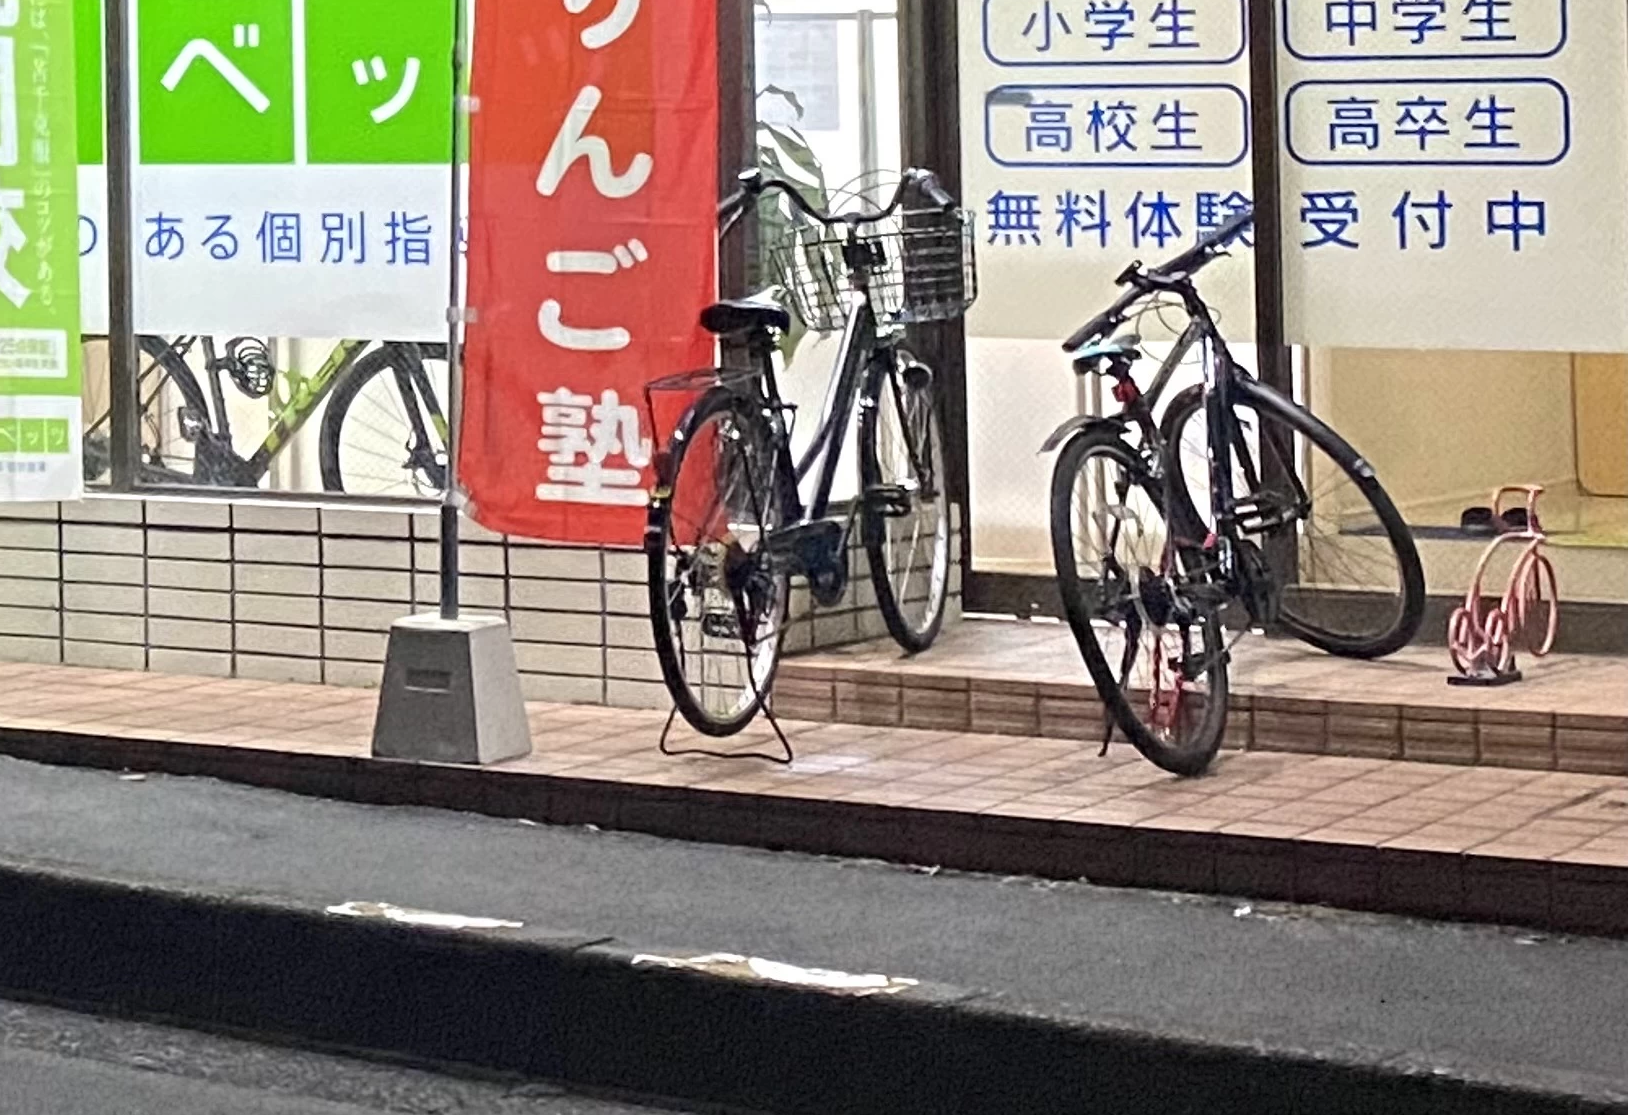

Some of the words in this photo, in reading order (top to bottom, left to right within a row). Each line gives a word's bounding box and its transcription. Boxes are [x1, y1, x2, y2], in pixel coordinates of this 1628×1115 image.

[1024, 97, 1204, 154] 高校生
[1327, 94, 1521, 153] 高卒生
[1300, 190, 1546, 251] 受付中
